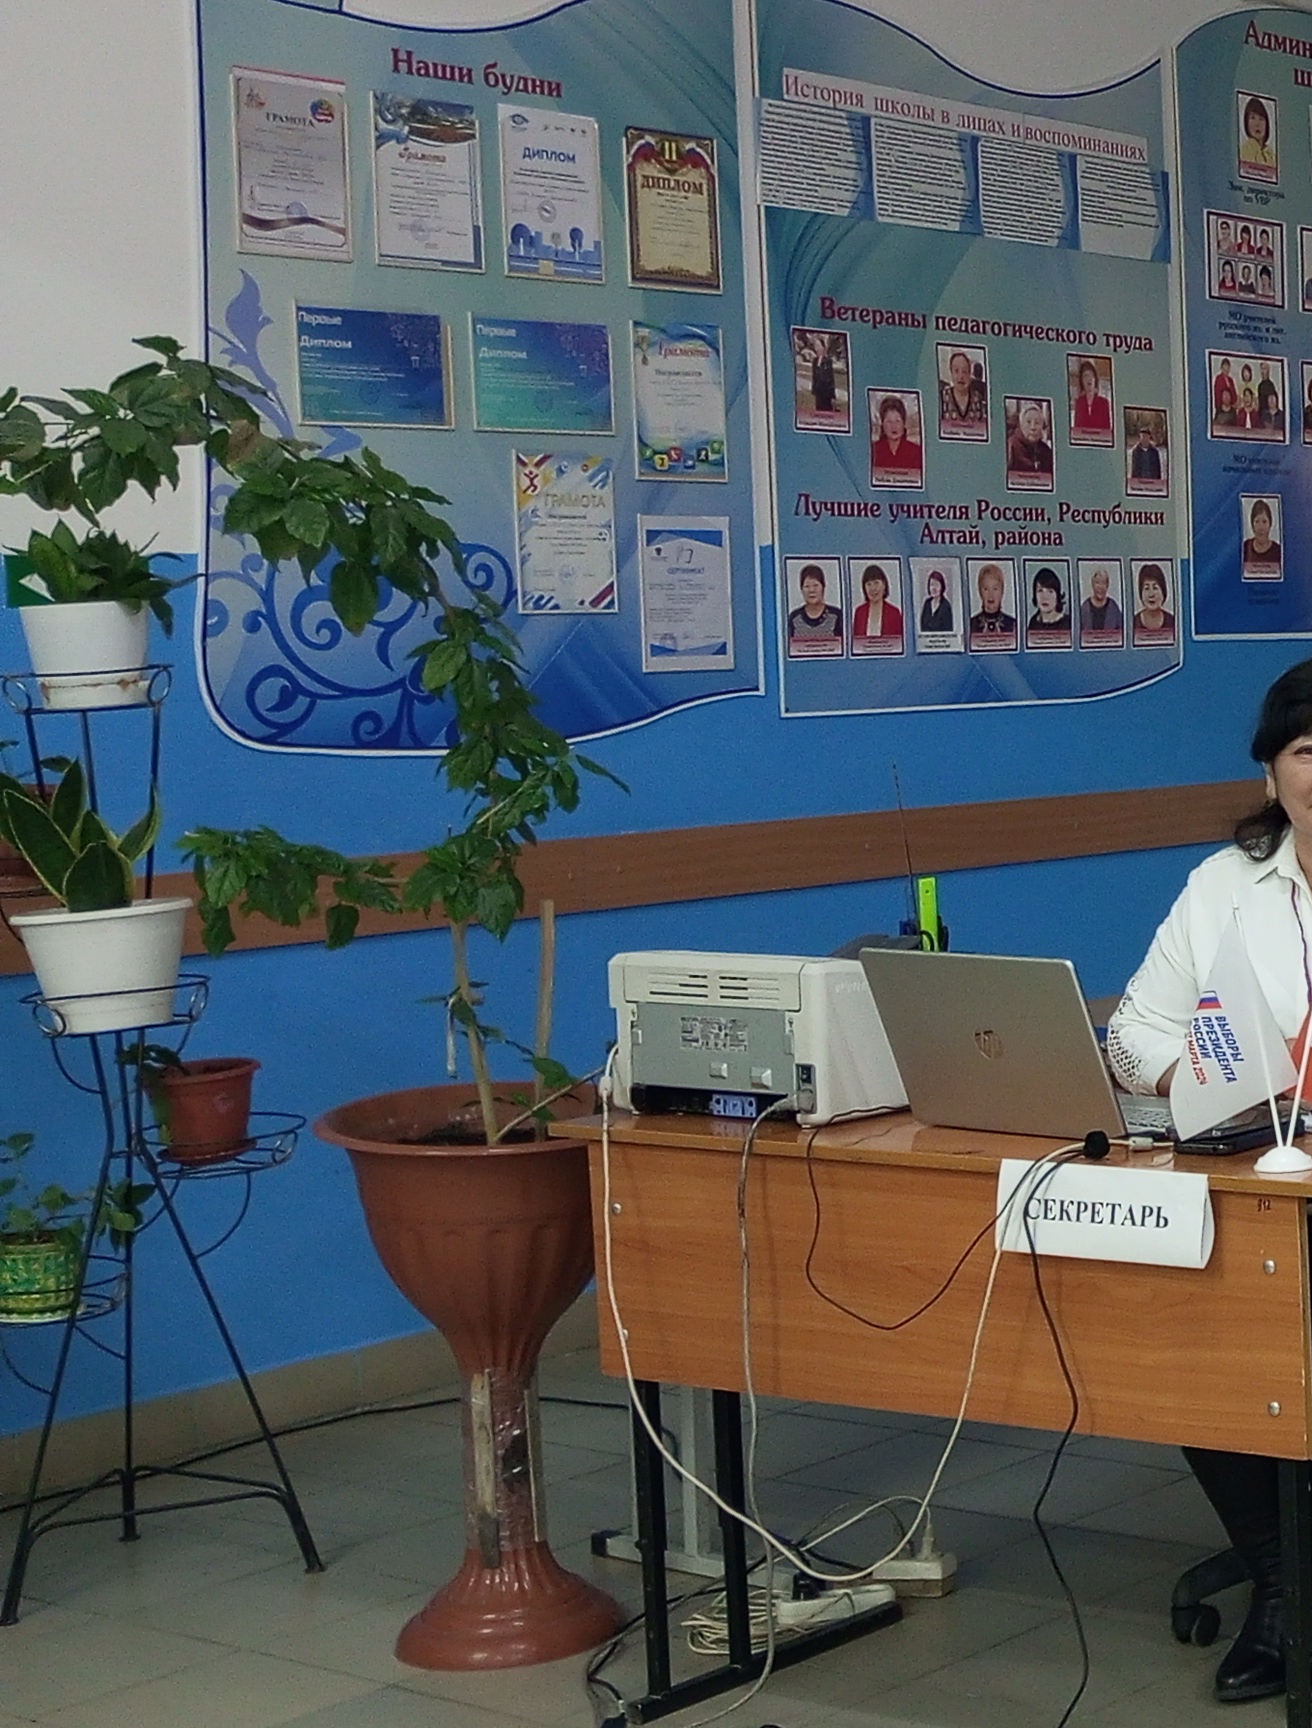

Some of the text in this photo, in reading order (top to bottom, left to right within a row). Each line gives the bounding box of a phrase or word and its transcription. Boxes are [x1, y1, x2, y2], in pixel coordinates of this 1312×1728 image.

[391, 48, 563, 98] Наши будни
[266, 112, 315, 128] ГРАМОТА
[783, 74, 864, 109] История
[874, 96, 935, 124] школы
[941, 109, 951, 124] в
[1011, 123, 1022, 138] и
[1024, 127, 1147, 161] воспоминаниях
[522, 146, 576, 164] ДИПЛОМ
[641, 174, 704, 196] ДИПЛОМ
[298, 311, 342, 326] Первые
[476, 324, 517, 338] Первые
[819, 297, 1154, 354] Ветераны педагогического труда
[300, 335, 352, 350] Диплом
[479, 347, 528, 360] Диплом
[794, 493, 1165, 528] Лучшие учителя России, Республики
[919, 523, 1064, 550] Алтай, района
[1201, 1016, 1237, 1083] ПРЕЗИДЕНТА
[1215, 1016, 1244, 1062] ВЫБОРЫ
[1026, 1197, 1170, 1229] СЕКРЕТАРЬ
